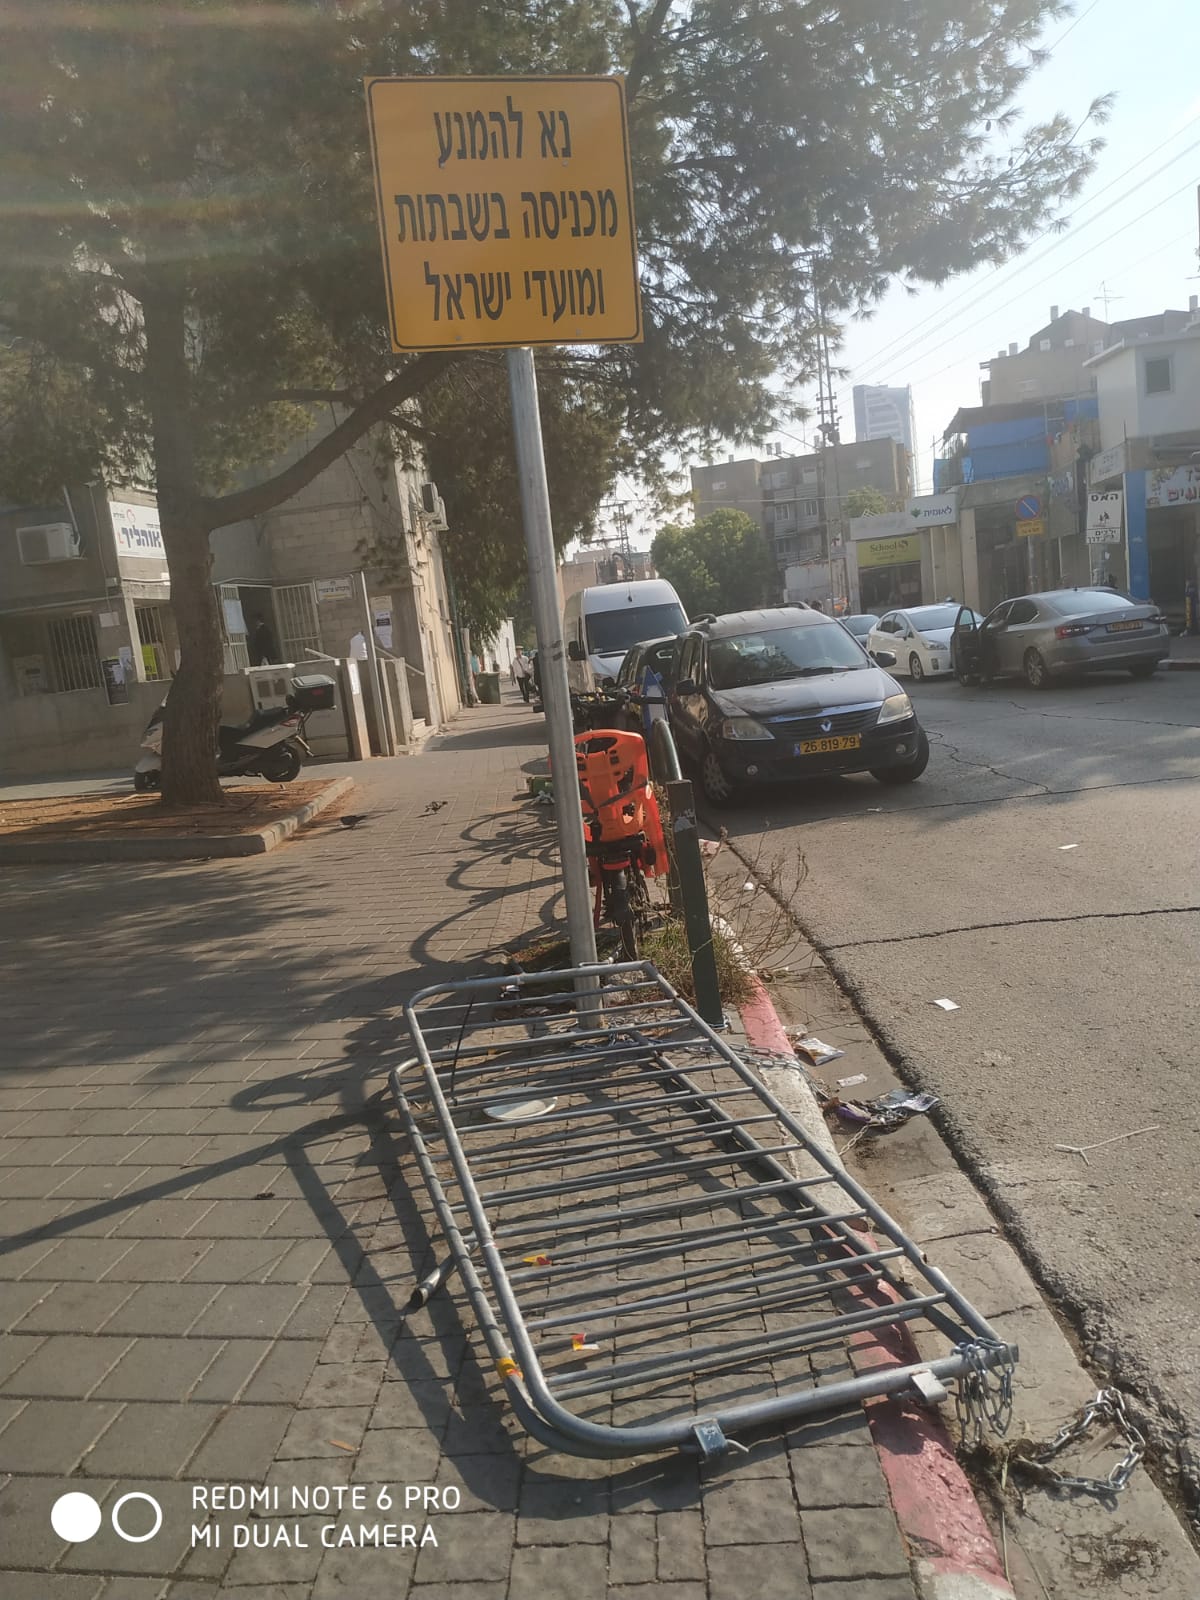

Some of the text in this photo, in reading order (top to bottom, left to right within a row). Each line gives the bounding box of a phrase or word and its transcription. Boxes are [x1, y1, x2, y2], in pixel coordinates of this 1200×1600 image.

[433, 95, 572, 168] נא להמנע
[394, 188, 618, 243] מכניסה בשבתות
[423, 260, 606, 324] ומועדי ישראל
[923, 505, 953, 518] לאומית
[870, 541, 897, 553] School
